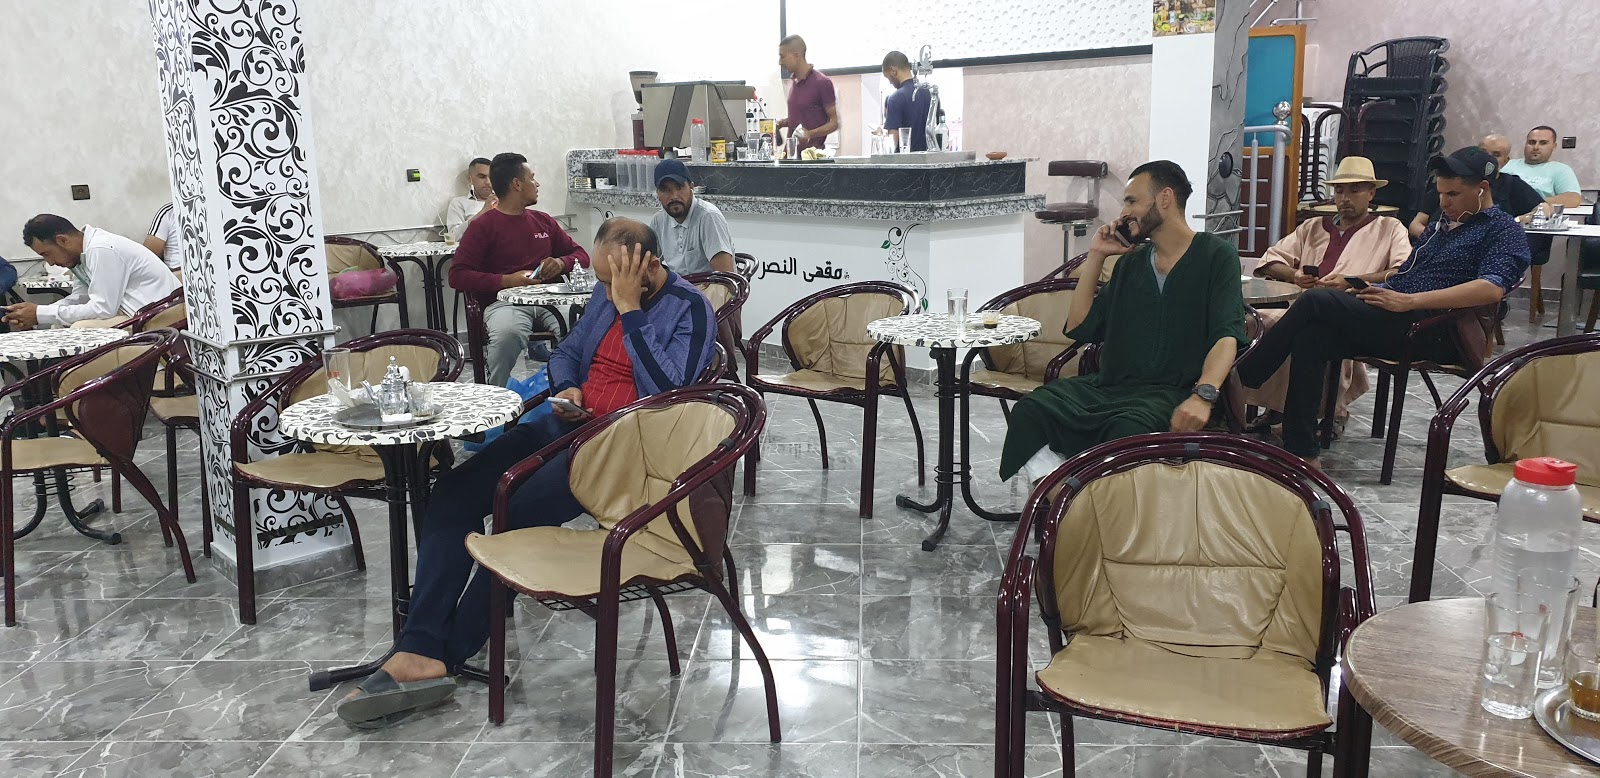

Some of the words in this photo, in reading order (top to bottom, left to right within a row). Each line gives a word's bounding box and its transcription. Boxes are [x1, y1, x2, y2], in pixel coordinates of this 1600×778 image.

[534, 231, 549, 239] FILA
[758, 256, 797, 280] النصر
[803, 260, 843, 283] مقهى
